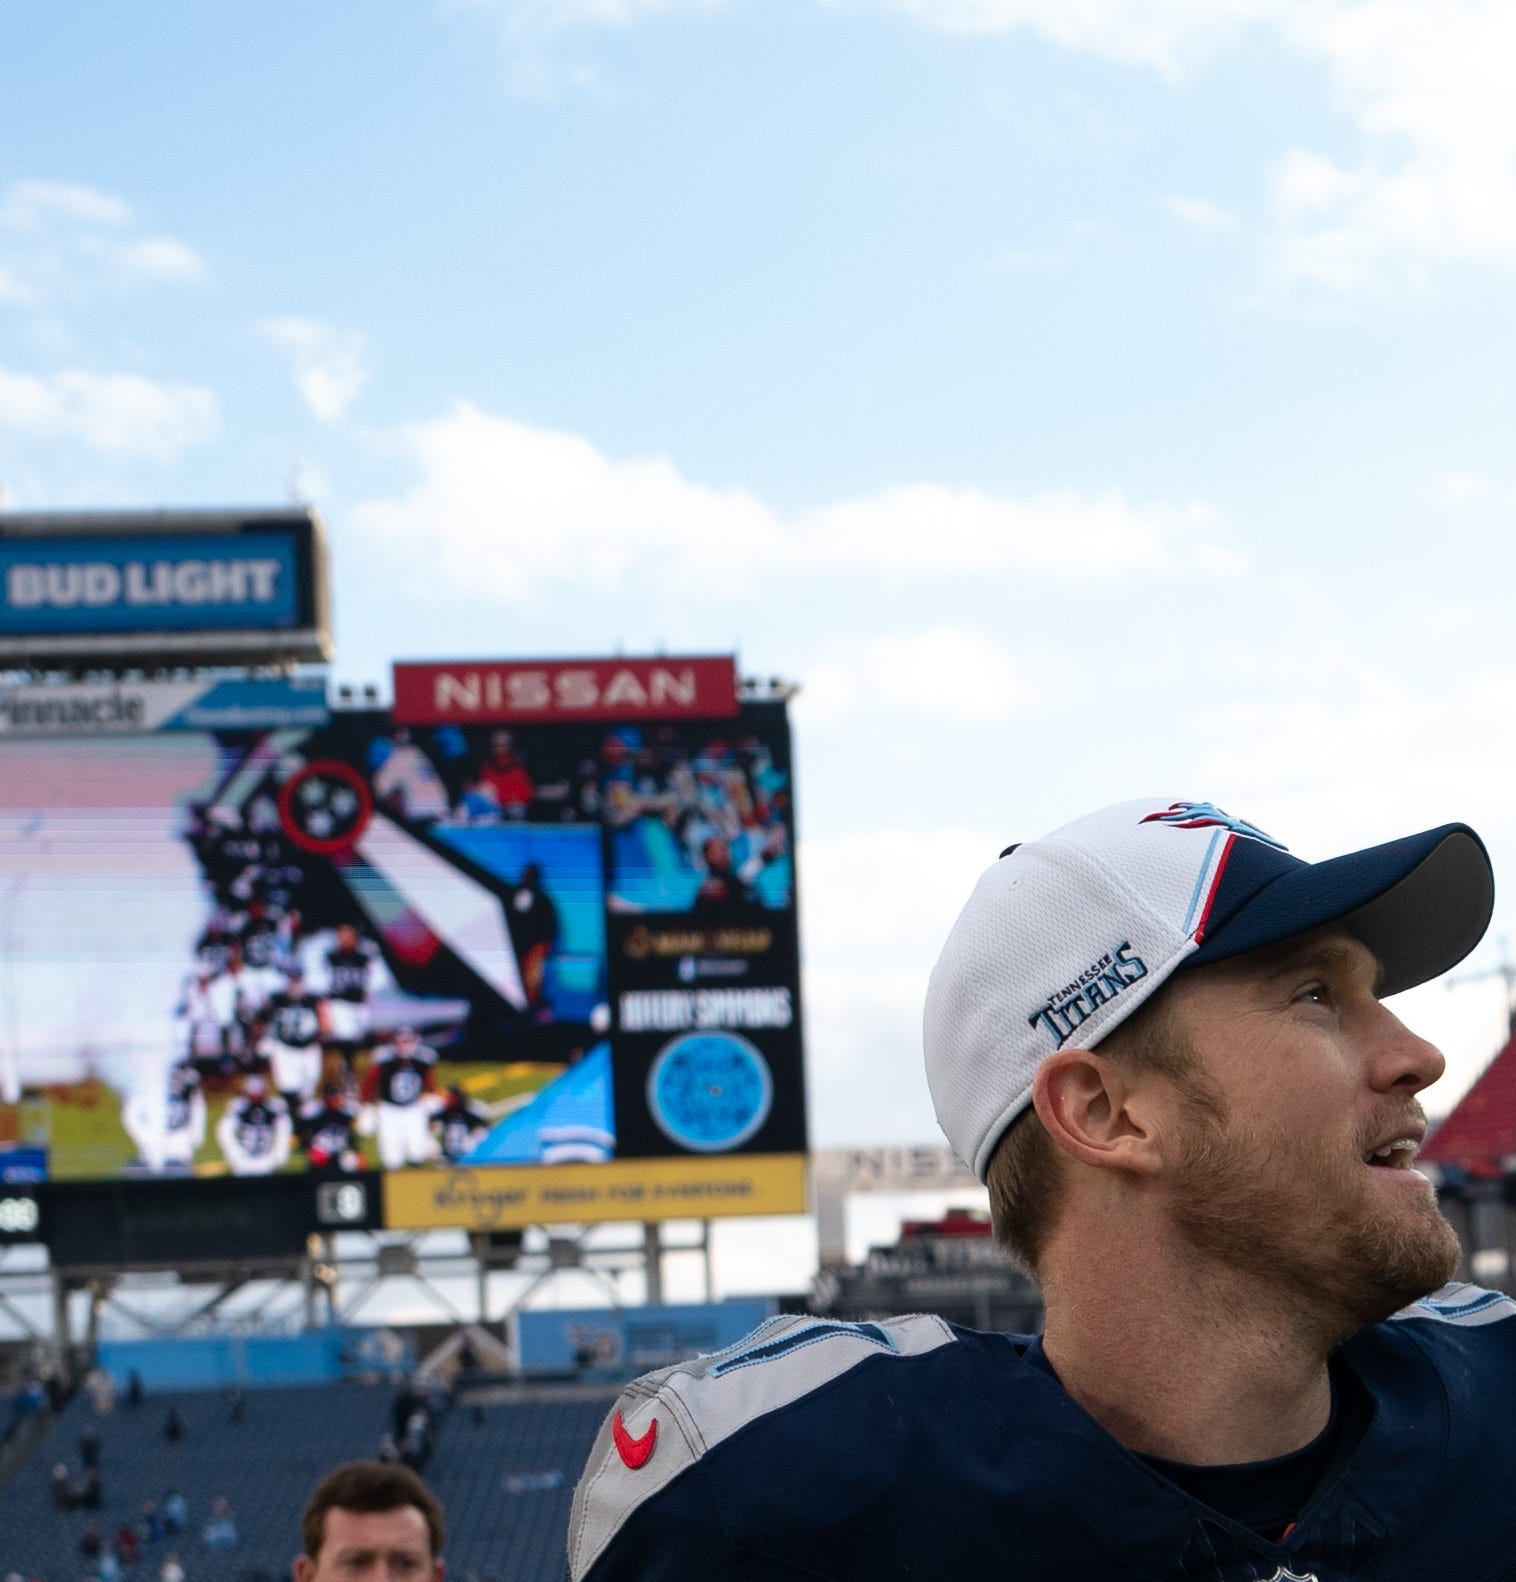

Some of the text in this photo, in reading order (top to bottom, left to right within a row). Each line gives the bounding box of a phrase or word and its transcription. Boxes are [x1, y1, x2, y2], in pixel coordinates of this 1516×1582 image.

[8, 557, 281, 608] BUD LIGHT
[433, 667, 697, 712] NISSAN
[1028, 940, 1148, 1051] TITANS
[1046, 953, 1114, 1006] TENNESSEE
